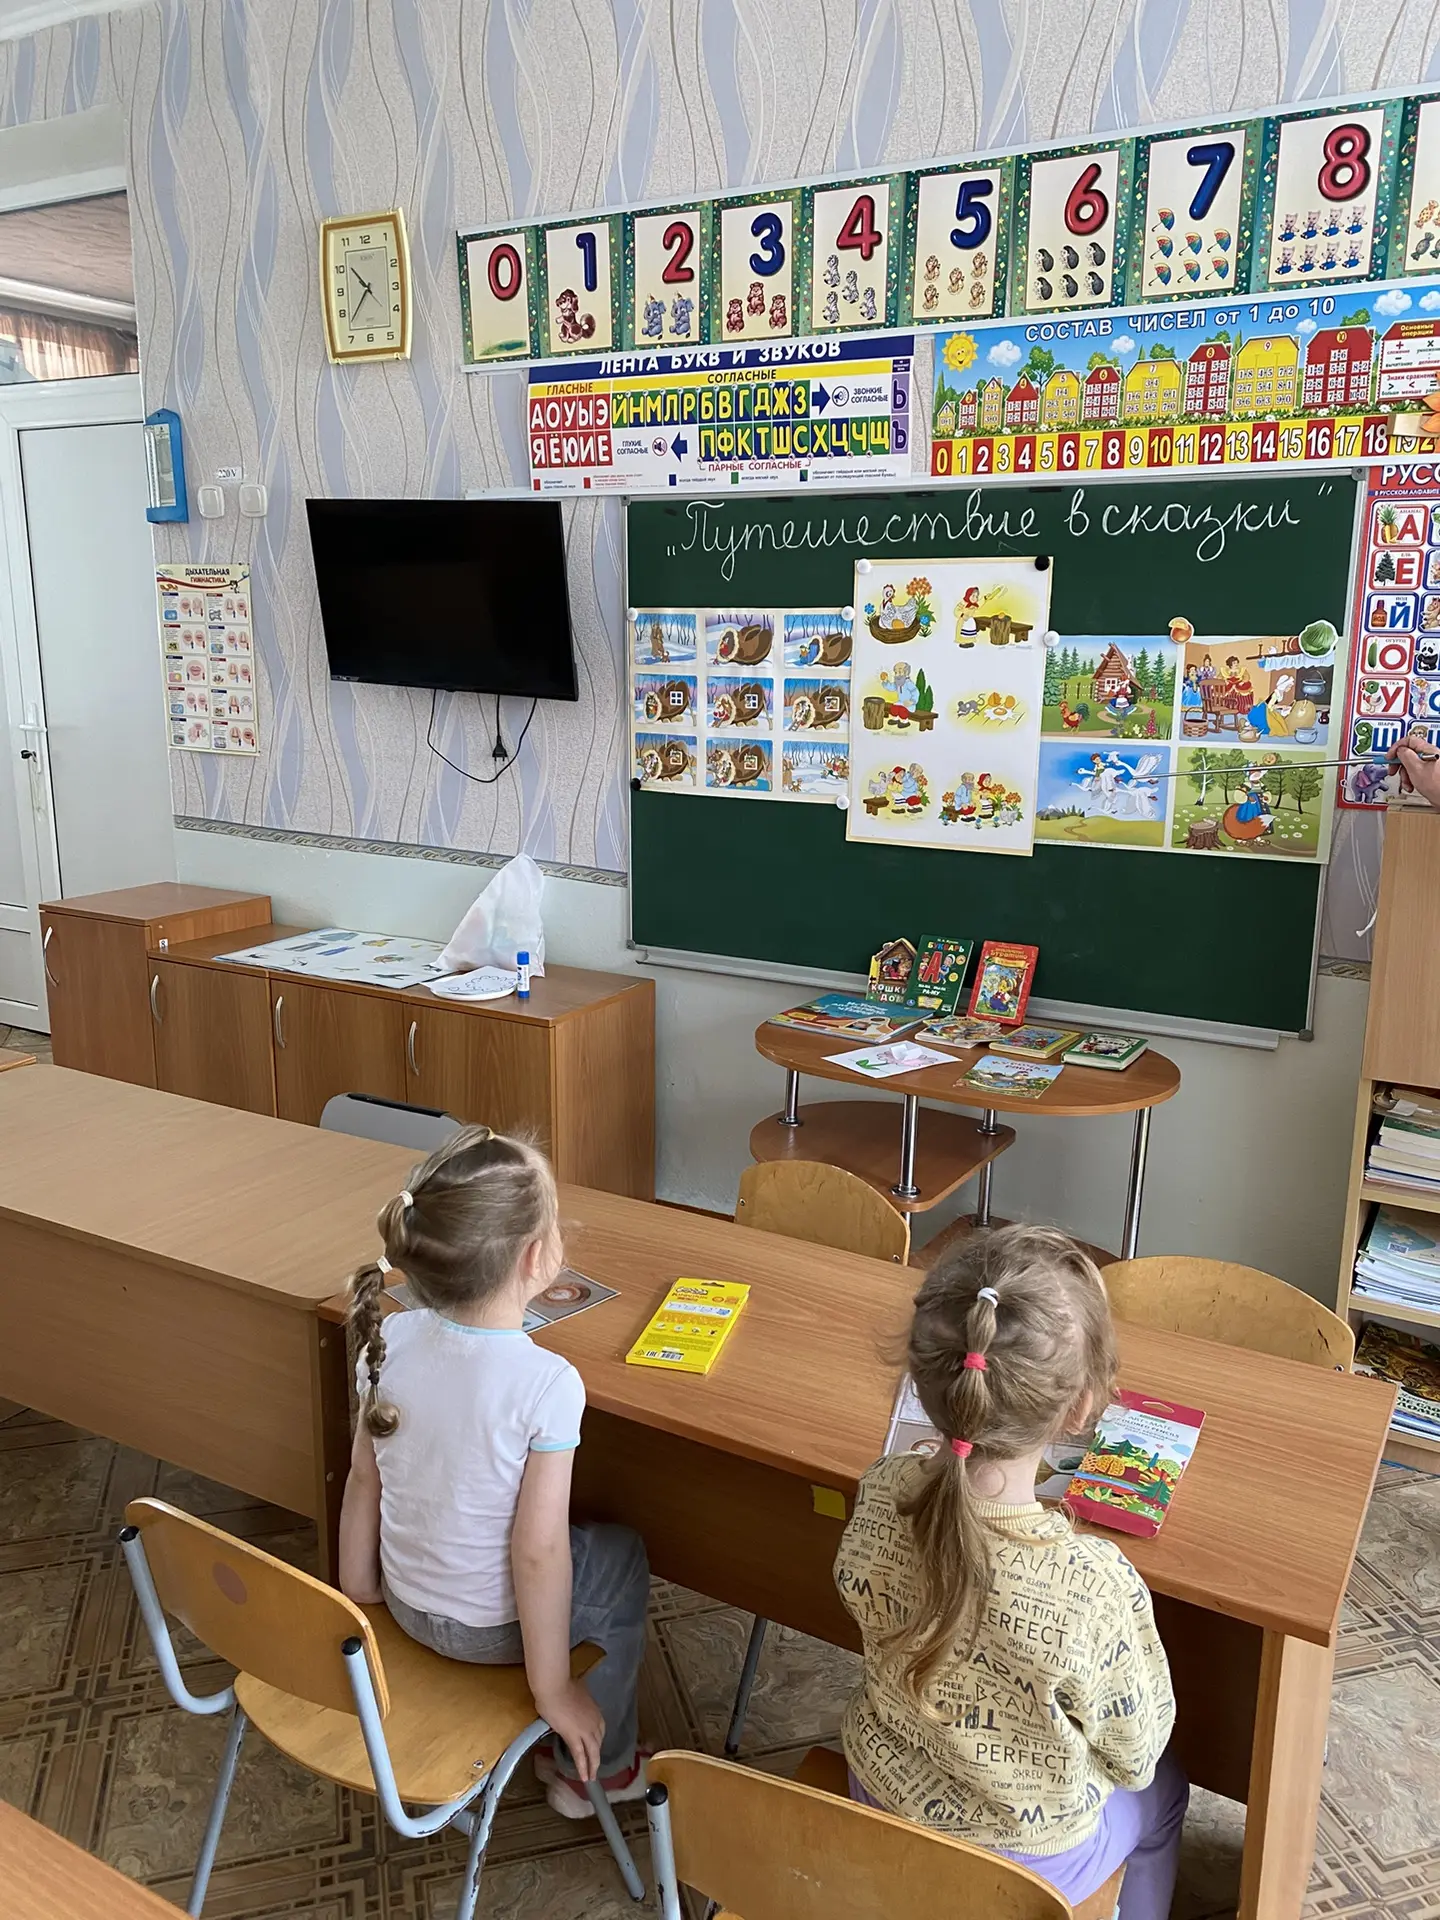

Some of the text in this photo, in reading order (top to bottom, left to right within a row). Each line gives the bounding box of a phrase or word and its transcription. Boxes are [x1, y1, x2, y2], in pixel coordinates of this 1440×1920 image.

[488, 123, 1371, 301] 0 1 2 3 4 5 6 7 8
[341, 237, 350, 247] 11
[359, 234, 371, 245] 12
[383, 232, 388, 242] 1
[335, 264, 345, 274] 10
[390, 258, 398, 268] 2
[336, 287, 345, 297] 9
[391, 281, 400, 291] 3
[338, 309, 346, 319] 8
[392, 303, 400, 313] 4
[1025, 296, 1336, 343] СОСТАВ ЧИСЕЛ от 1 до 10
[348, 335, 355, 345] 7
[366, 333, 375, 343] 6
[386, 331, 395, 341] 5
[598, 343, 842, 375] ЛЕНТА БУКВ И ЗВУКОВ
[707, 369, 777, 384] СОГЛАСНЫЕ
[546, 382, 593, 396] ГЛАСНЫЕ
[853, 387, 883, 395] ЗВОНКИЕ
[851, 395, 888, 403] СОГЛАСНЫЕ
[936, 447, 949, 474] 0
[957, 445, 968, 474] 1
[976, 445, 990, 473] 2
[997, 443, 1010, 471] 3
[1017, 442, 1032, 470] 4
[1040, 441, 1054, 469] 5
[1062, 440, 1076, 468] 6
[1085, 439, 1099, 467] 7
[1106, 437, 1120, 466] 8
[1129, 436, 1144, 465] 9
[1149, 434, 1171, 464] 10
[1175, 433, 1195, 463] 11
[1200, 432, 1223, 462] 12
[1226, 430, 1250, 461] 13
[1253, 429, 1276, 460] 14
[1279, 427, 1303, 458] 15
[1307, 426, 1331, 457] 16
[1334, 425, 1361, 456] 17
[1364, 423, 1388, 454] 18
[708, 460, 801, 472] ПАРНЫЕ СОГЛАСНЫЕ
[218, 469, 231, 478] 220
[1064, 488, 1090, 537] в
[1397, 514, 1420, 541] А
[185, 568, 230, 576] ДЫХАТЕЛЬНАЯ
[1395, 558, 1415, 584] Е
[190, 576, 226, 584] ГИМНАСТИКА
[1388, 602, 1411, 628] Й
[1379, 644, 1407, 670] О
[1380, 686, 1403, 712] У
[1372, 727, 1398, 752] Ш
[927, 941, 965, 953] БУКВАРЬ
[1066, 1589, 1093, 1605] FREE
[937, 1679, 964, 1691] FREE
[936, 1688, 972, 1702] THERE
[976, 1742, 1071, 1771] PERFECT
